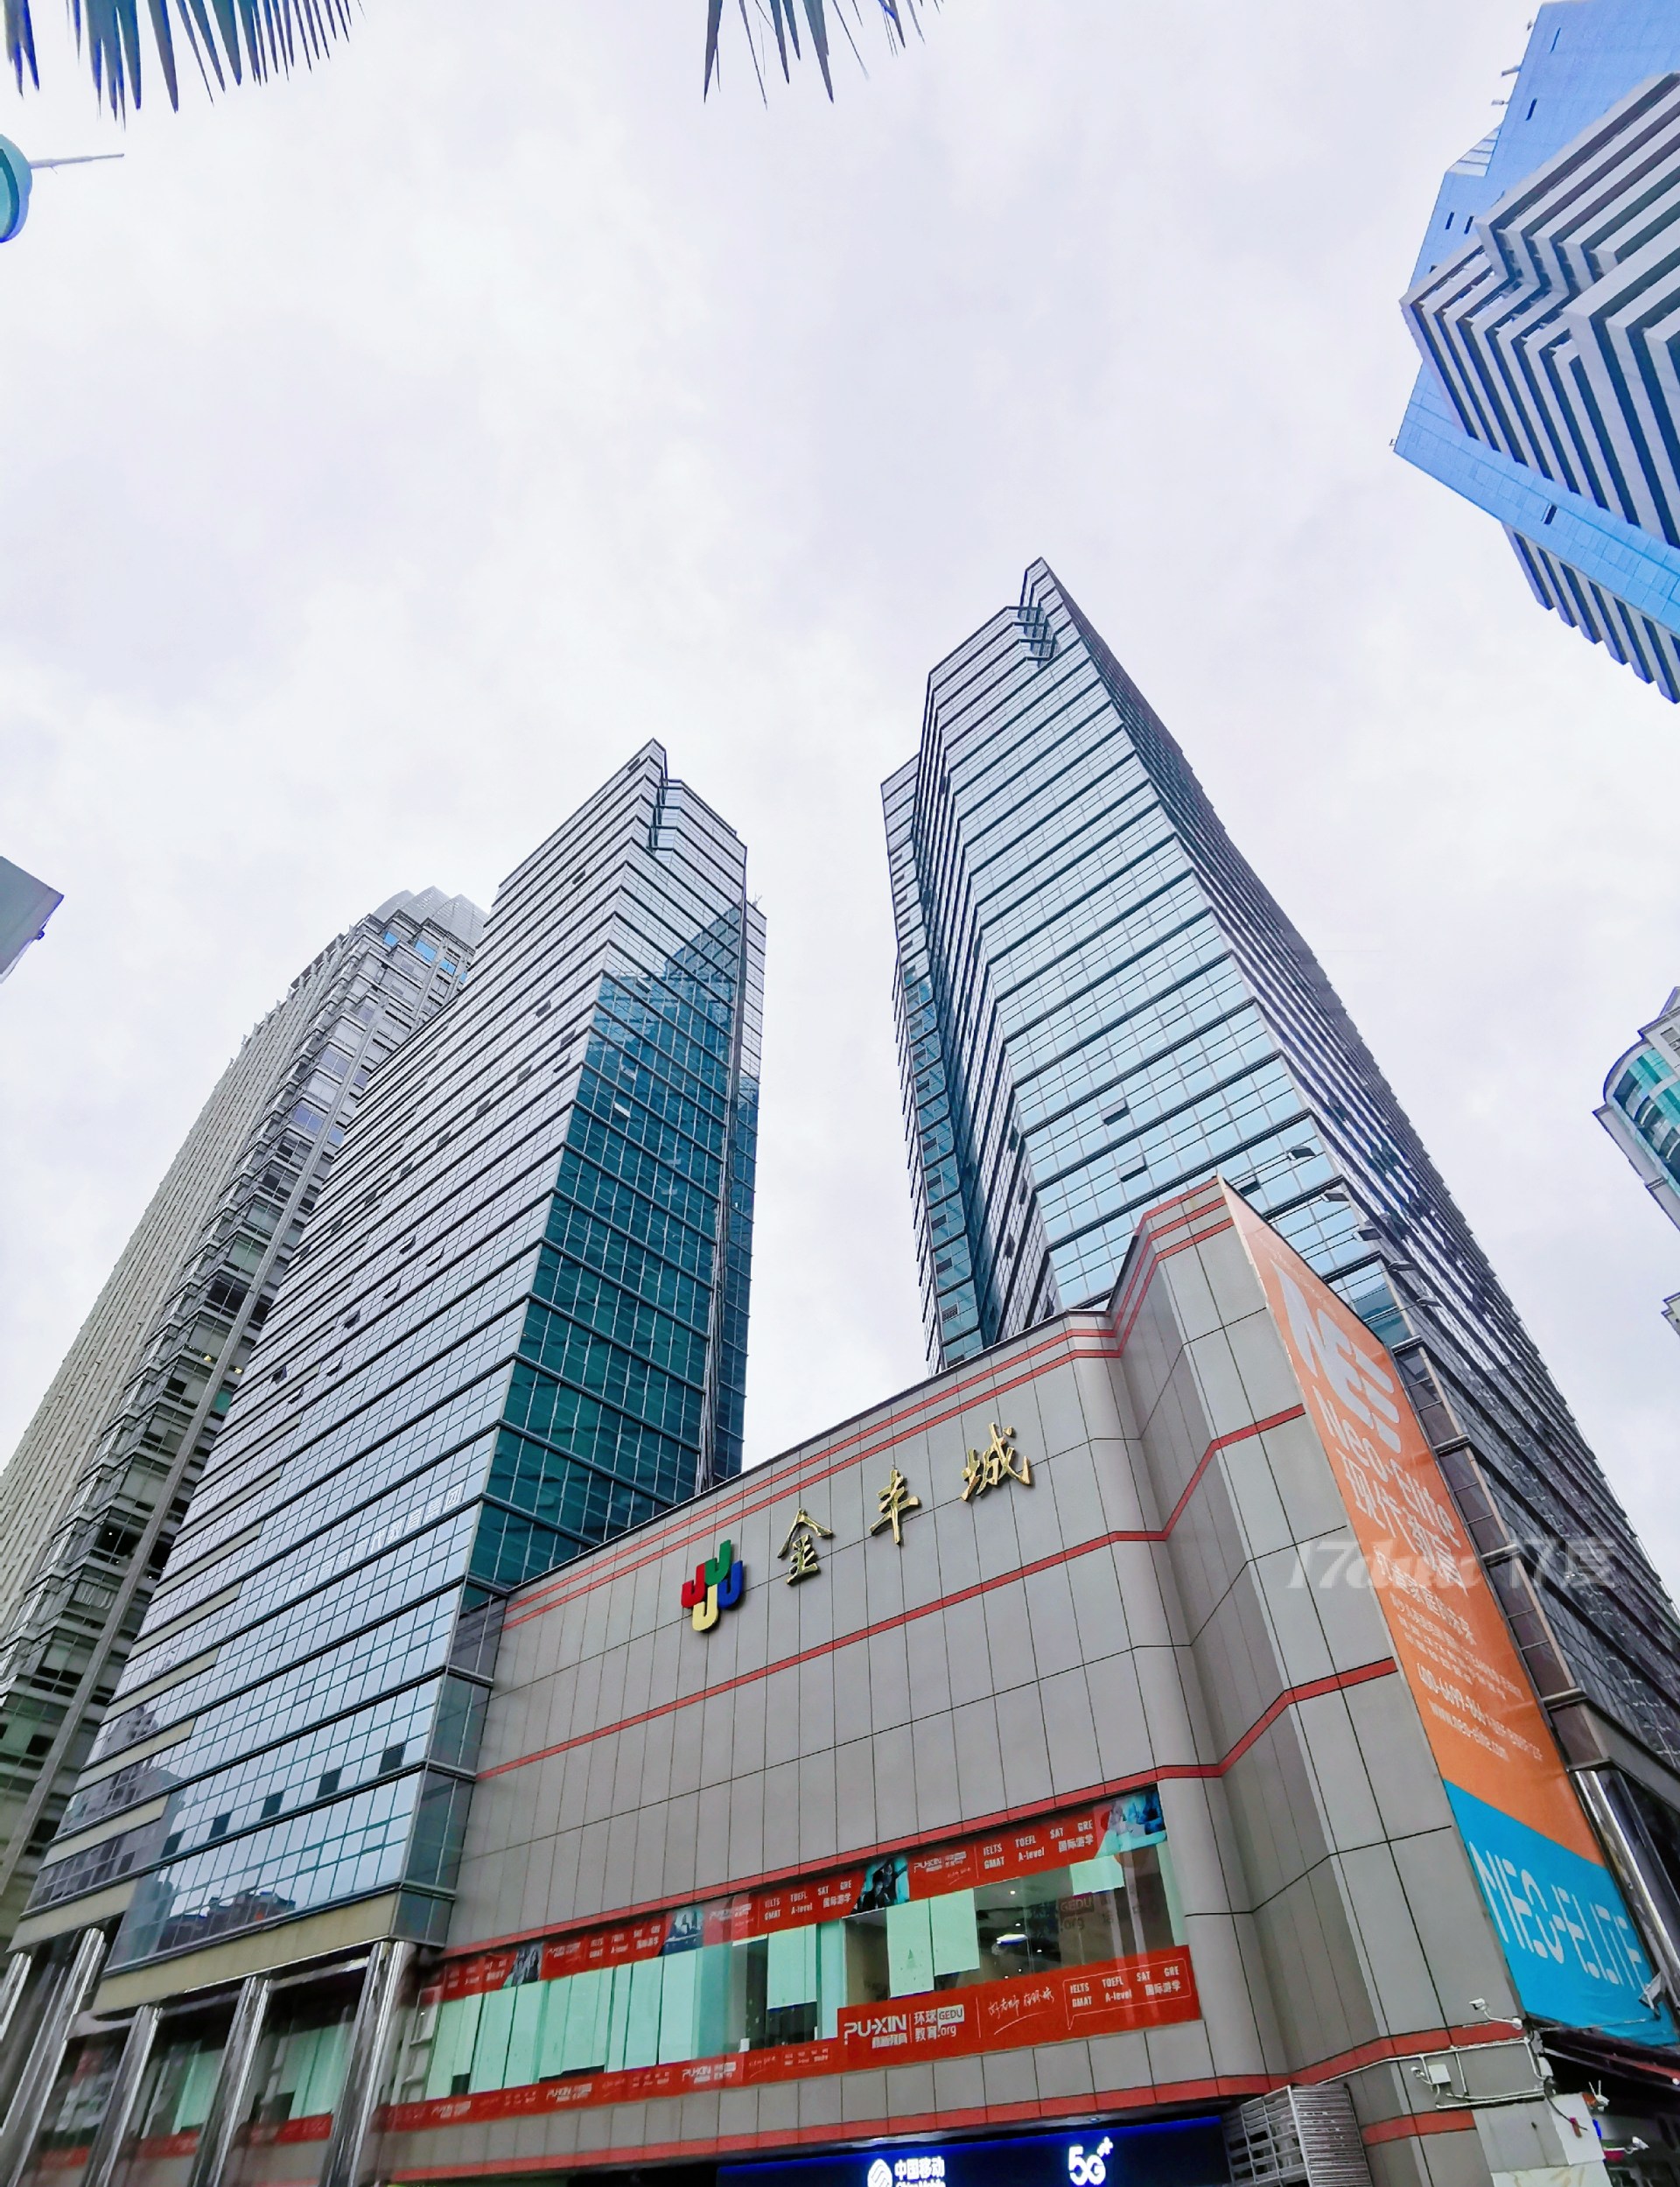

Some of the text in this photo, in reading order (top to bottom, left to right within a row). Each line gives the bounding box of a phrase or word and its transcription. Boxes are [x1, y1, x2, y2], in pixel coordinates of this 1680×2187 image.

[1312, 1386, 1461, 1548] Neo-Elite
[1335, 1447, 1469, 1596] 现代教育
[983, 1819, 1093, 1856] IELTS TOEFL SAT GRE
[984, 1856, 1004, 1869] GMAT
[1018, 1847, 1045, 1861] A-level
[817, 1885, 829, 1896] SAT
[1469, 1840, 1648, 1994] NEO-ELITE
[1070, 1966, 1180, 1994] IELTS TOEFL SAT GRE
[1072, 1995, 1092, 2008] GMAT
[1105, 1989, 1132, 2002] A-level
[939, 2008, 962, 2021] GEDU
[894, 2155, 945, 2180] 中国移动
